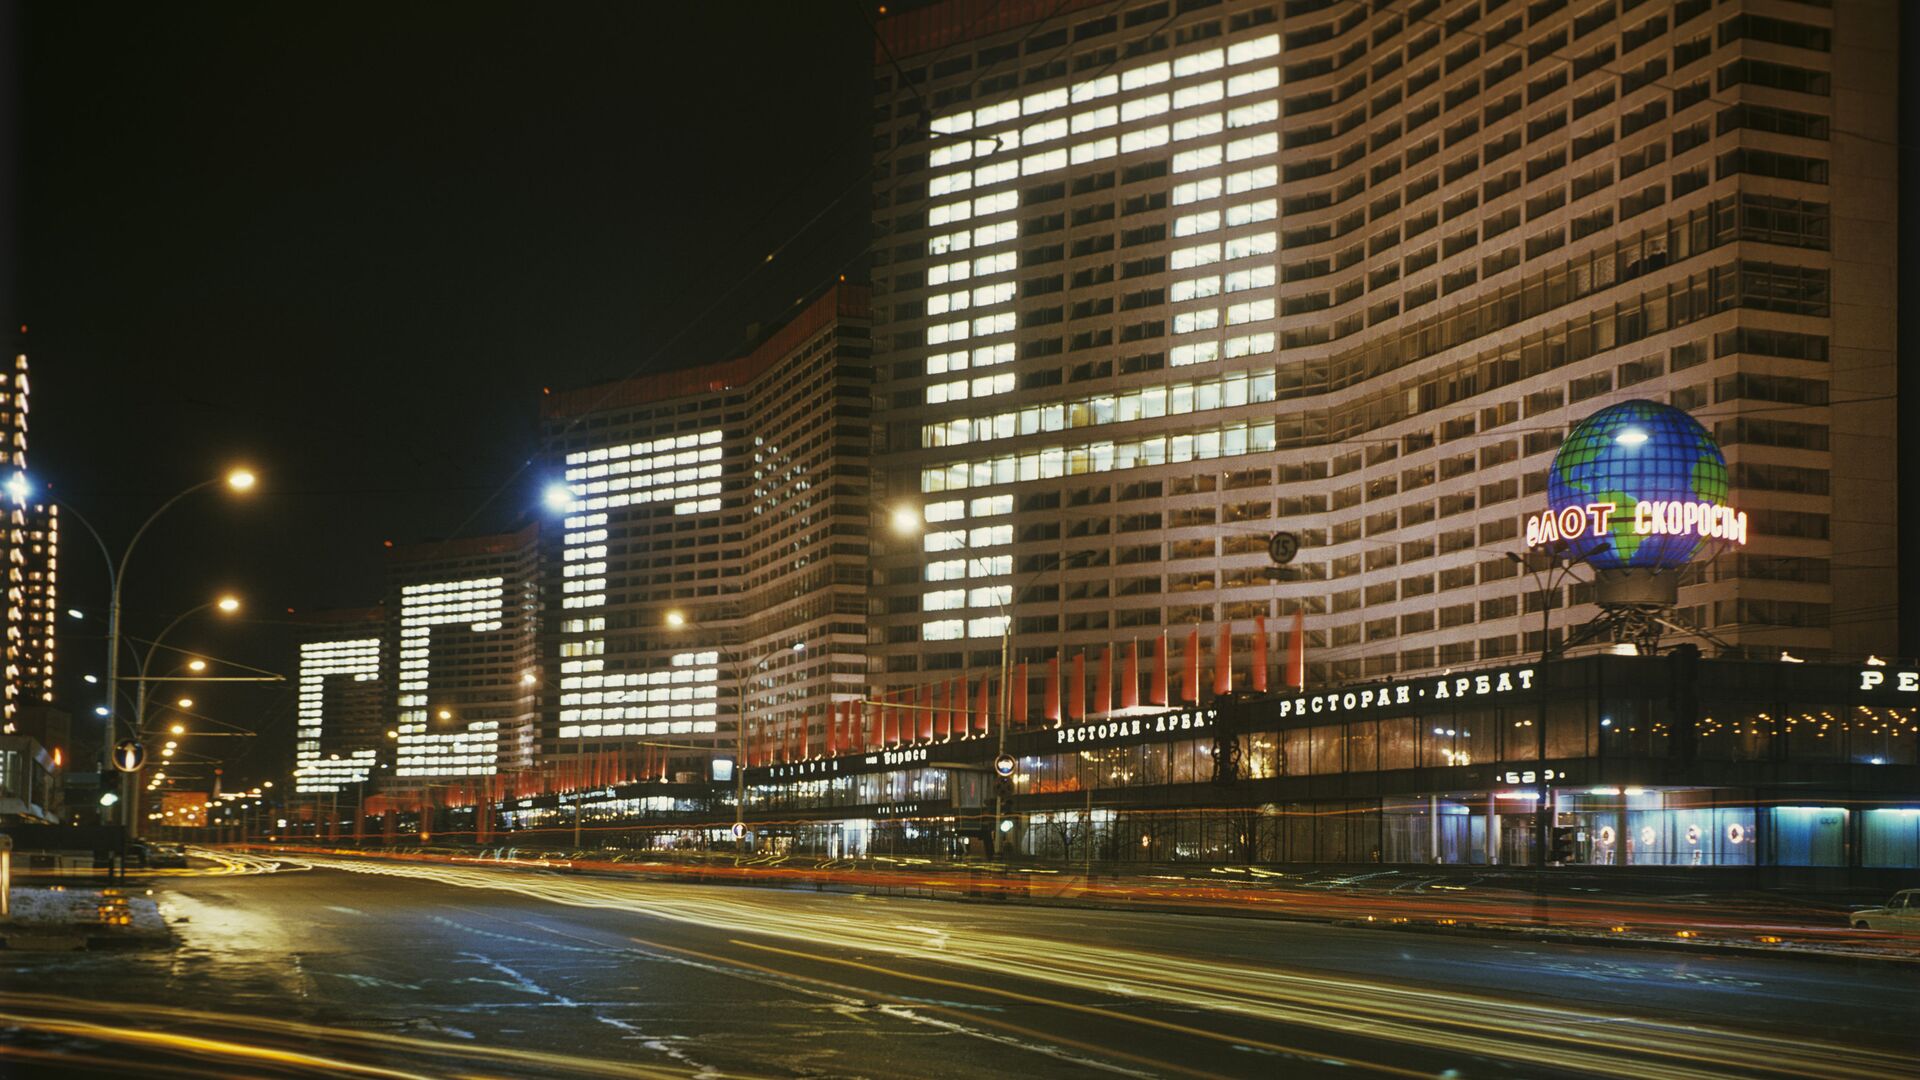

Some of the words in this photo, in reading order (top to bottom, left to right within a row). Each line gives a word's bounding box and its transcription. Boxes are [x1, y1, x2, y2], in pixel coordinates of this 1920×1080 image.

[1280, 685, 1410, 717] РЕСТОРАН
[1435, 669, 1534, 698] АРБАТ
[1057, 720, 1141, 743] РЕСТОРАН
